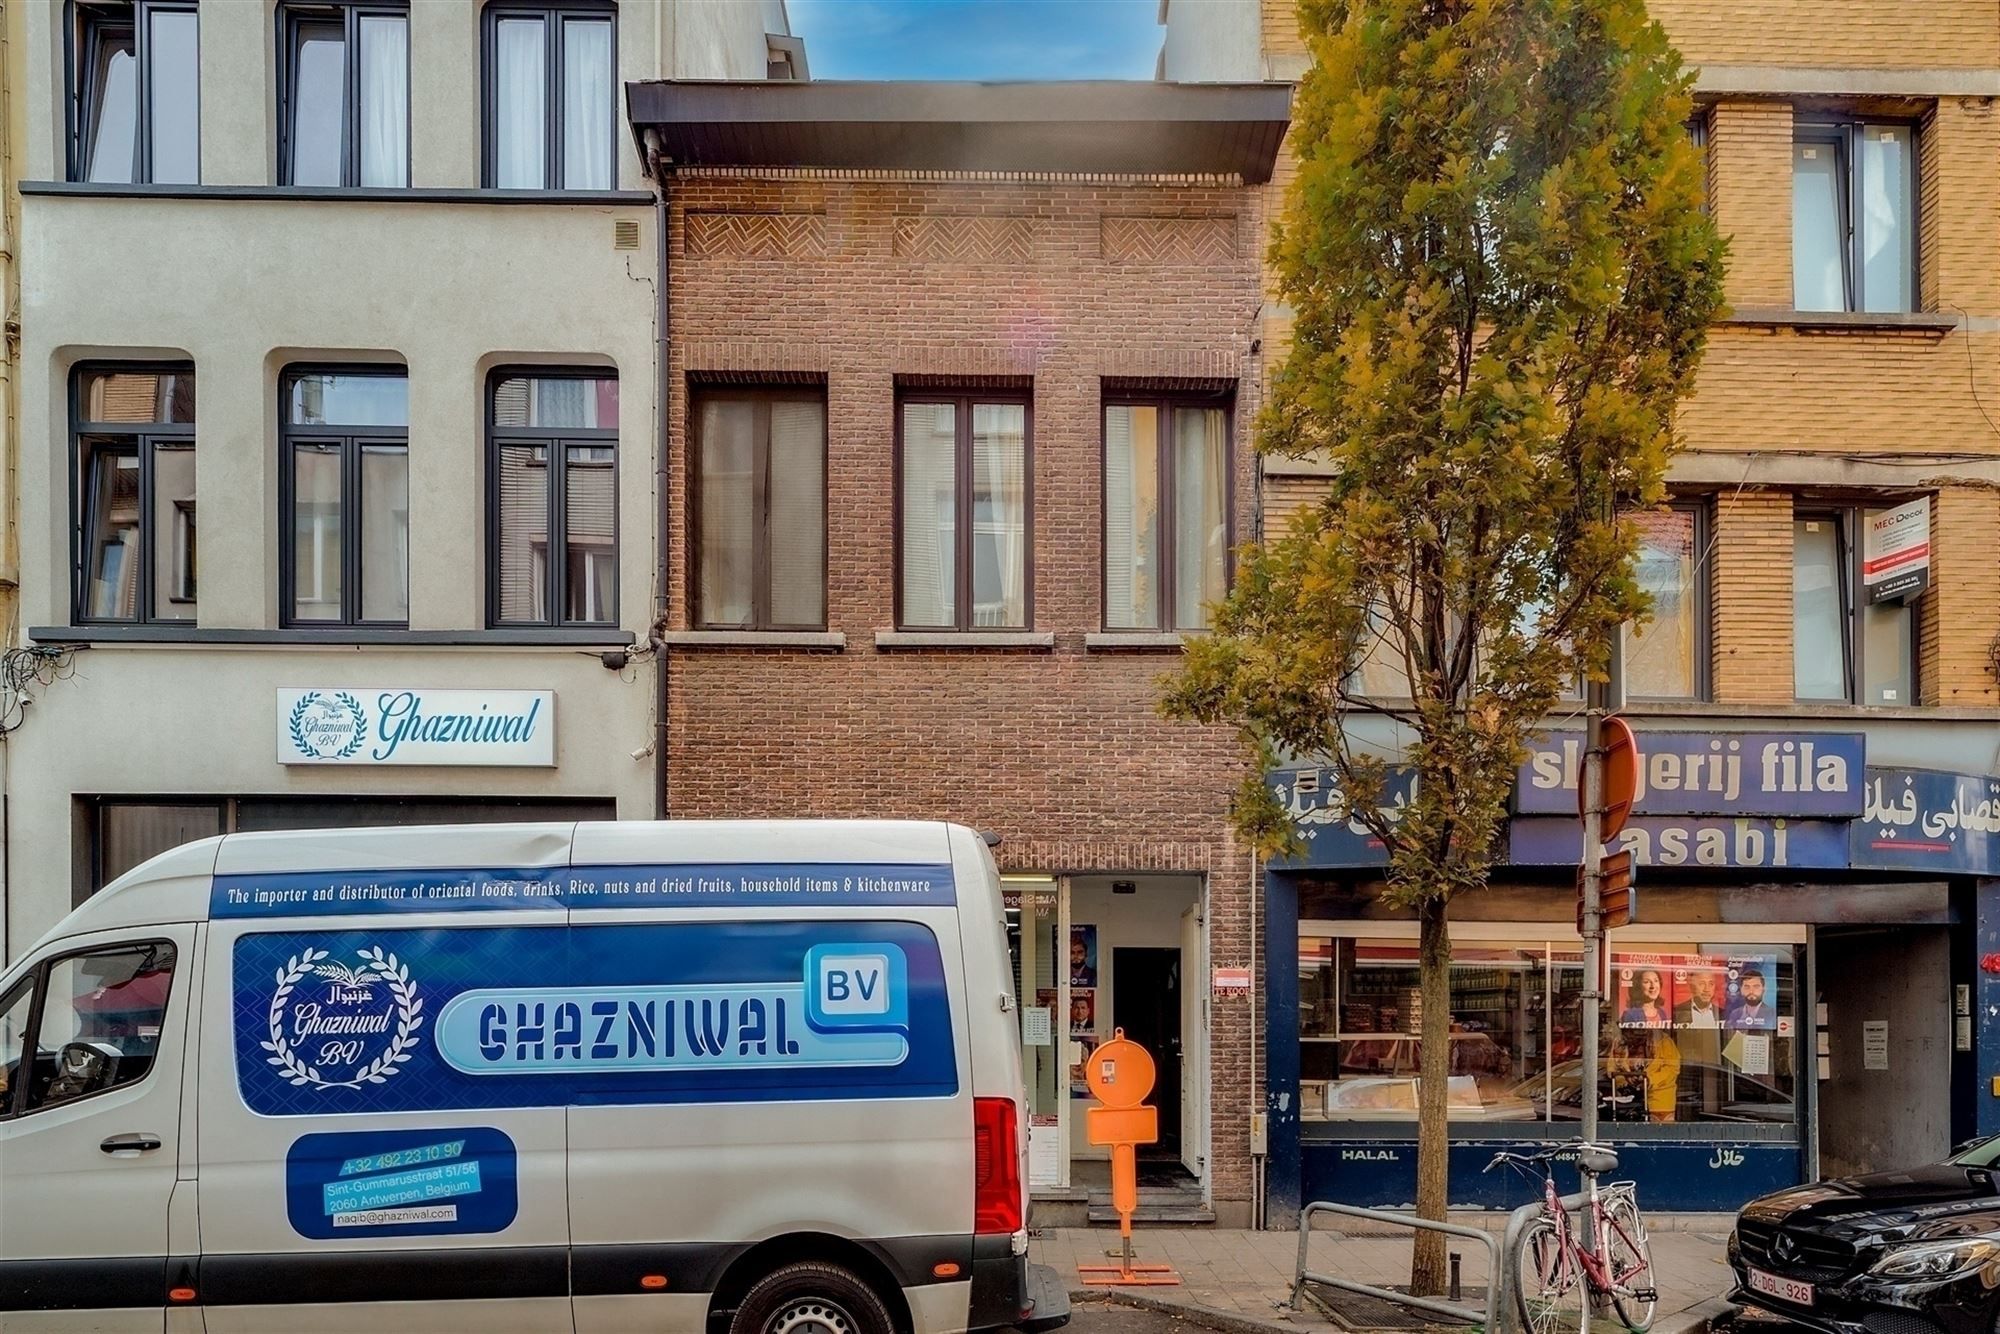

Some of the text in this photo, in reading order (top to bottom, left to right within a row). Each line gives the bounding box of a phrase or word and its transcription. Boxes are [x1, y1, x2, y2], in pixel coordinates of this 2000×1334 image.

[1874, 508, 1925, 532] MEC Decor
[304, 717, 354, 736] Ghazniwal
[316, 734, 341, 746] BV
[373, 692, 541, 760] Ghazniwal
[1532, 740, 1849, 802] slerij fila
[228, 876, 931, 907] The importer and distributor of oriental foods, drinks, Rice, nuts and dried fruits, household items & kitchenware
[826, 969, 879, 1001] BV
[291, 1003, 394, 1047] Ghazniwal
[479, 997, 800, 1061] GHAZNIWAL
[315, 1040, 364, 1065] BV
[344, 1143, 461, 1172] +32 492 23 10 90
[1342, 1151, 1399, 1161] HALAL
[327, 1162, 477, 1197] Sint-Gummarusstraat 51/56
[330, 1180, 470, 1212] 2060 Antwerpen, Belgium
[337, 1208, 454, 1225] naqib@ghazniwal.com
